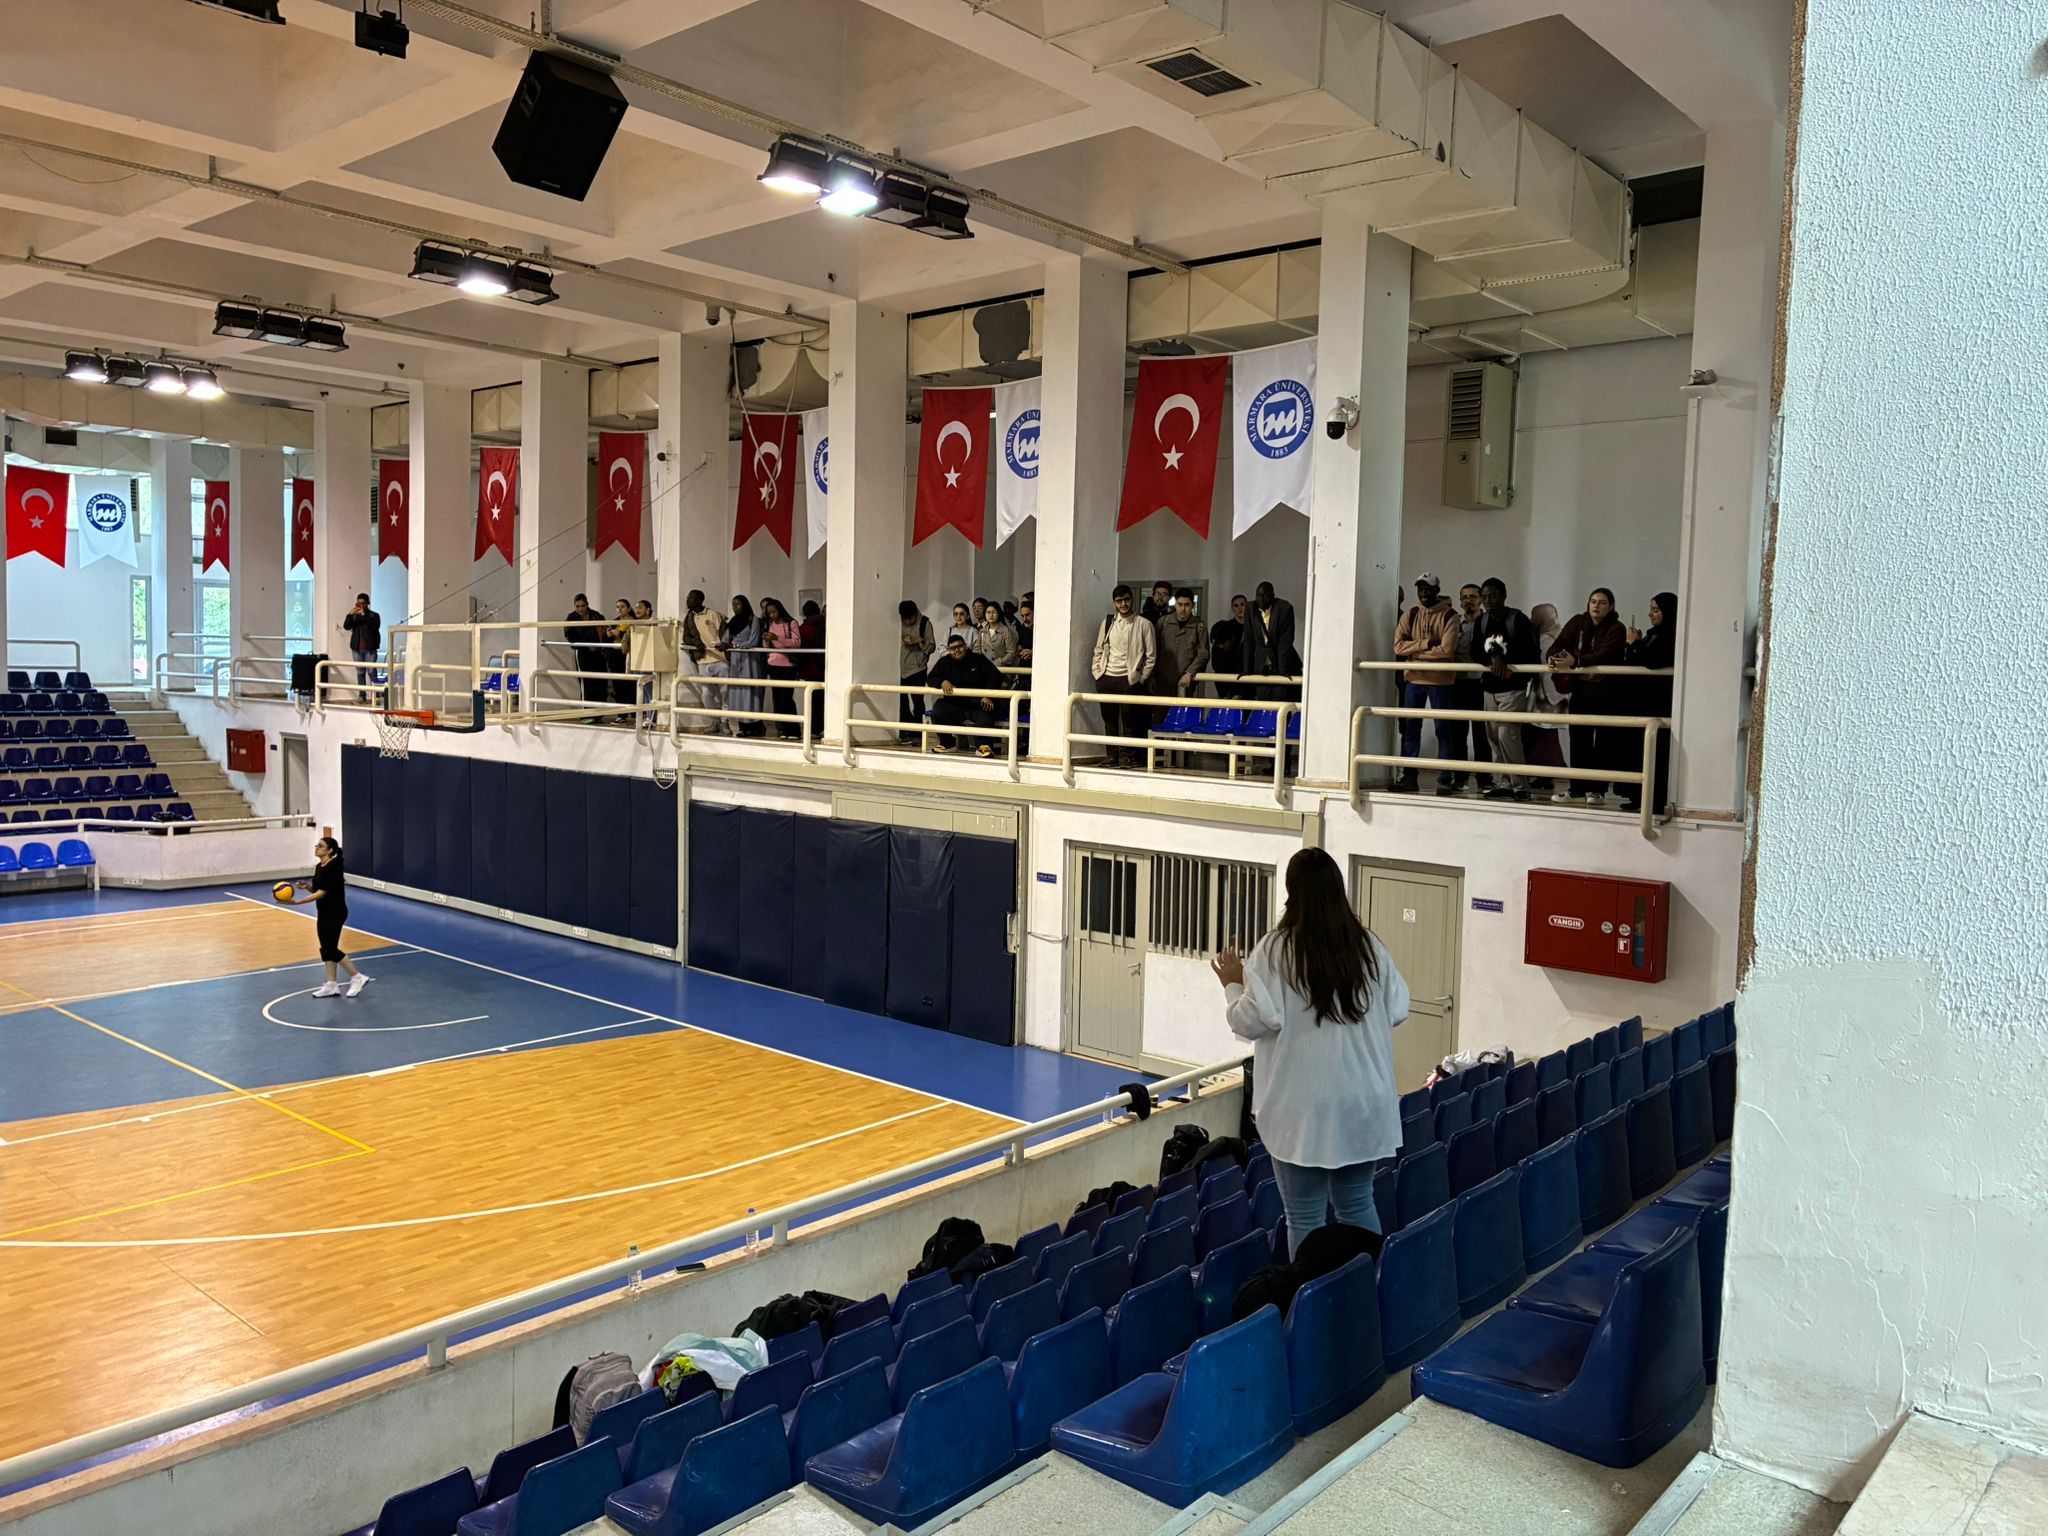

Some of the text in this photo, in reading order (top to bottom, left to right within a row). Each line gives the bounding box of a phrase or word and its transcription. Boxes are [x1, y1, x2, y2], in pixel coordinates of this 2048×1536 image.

[1248, 389, 1273, 442] MARMARA
[1006, 415, 1026, 464] MARMARA
[1270, 446, 1289, 457] 1883
[1552, 917, 1581, 928] YANGIN
